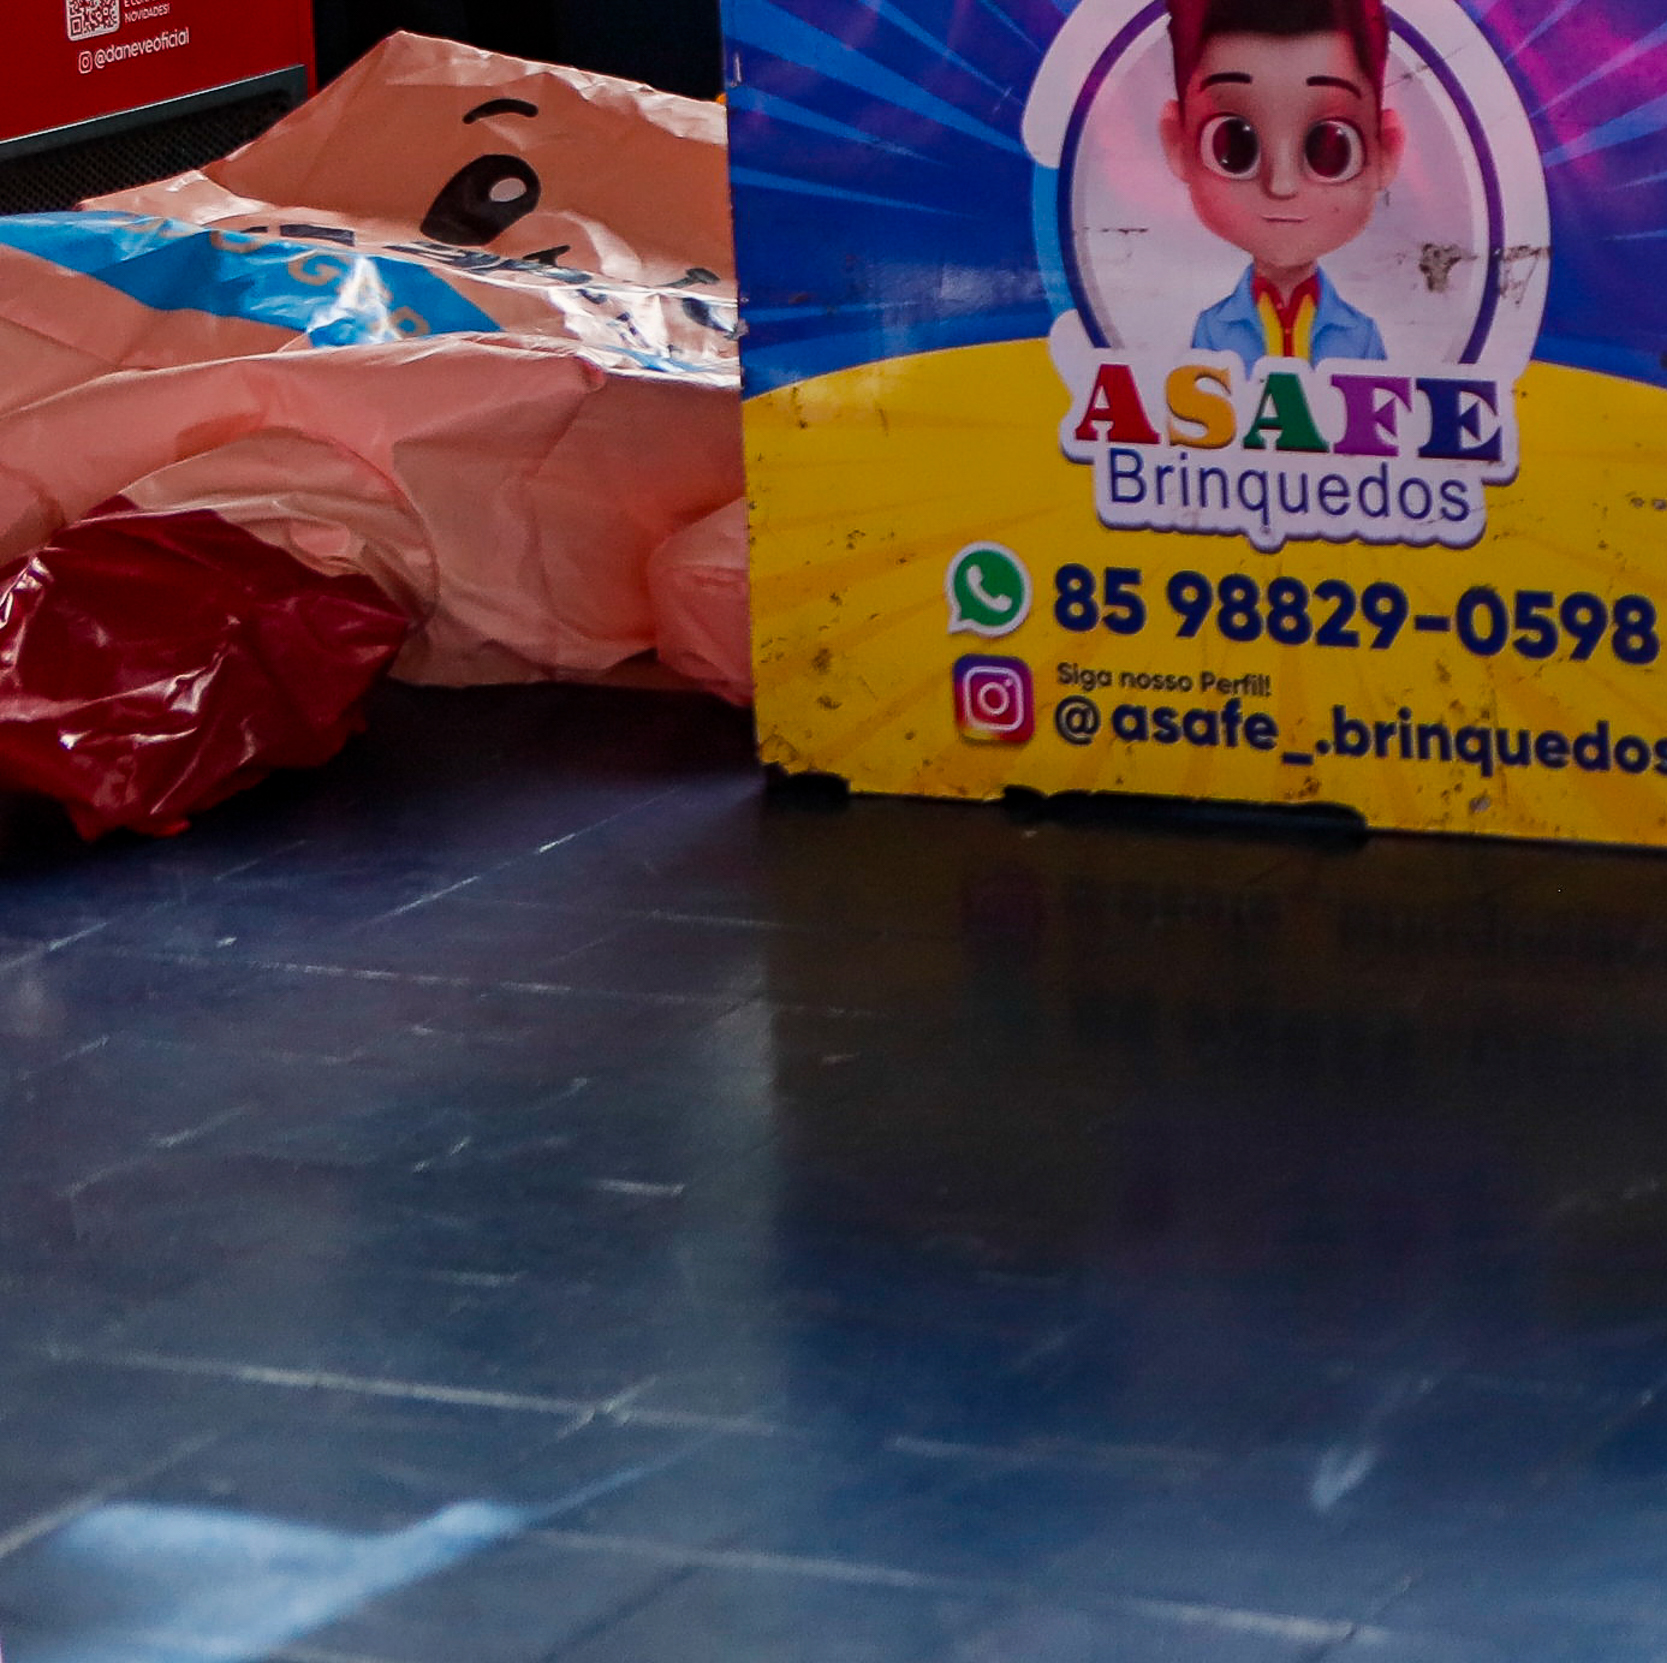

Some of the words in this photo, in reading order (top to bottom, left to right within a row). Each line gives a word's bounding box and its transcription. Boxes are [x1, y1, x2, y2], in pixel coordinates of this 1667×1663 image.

[94, 27, 190, 69] @daneveoficial
[1075, 362, 1501, 462] ASAFE
[1109, 447, 1470, 526] Brinquedos
[1053, 563, 1147, 635] 85
[1166, 571, 1661, 665] 98829-0598
[1057, 662, 1112, 692] Siga
[1120, 671, 1193, 693] nosso
